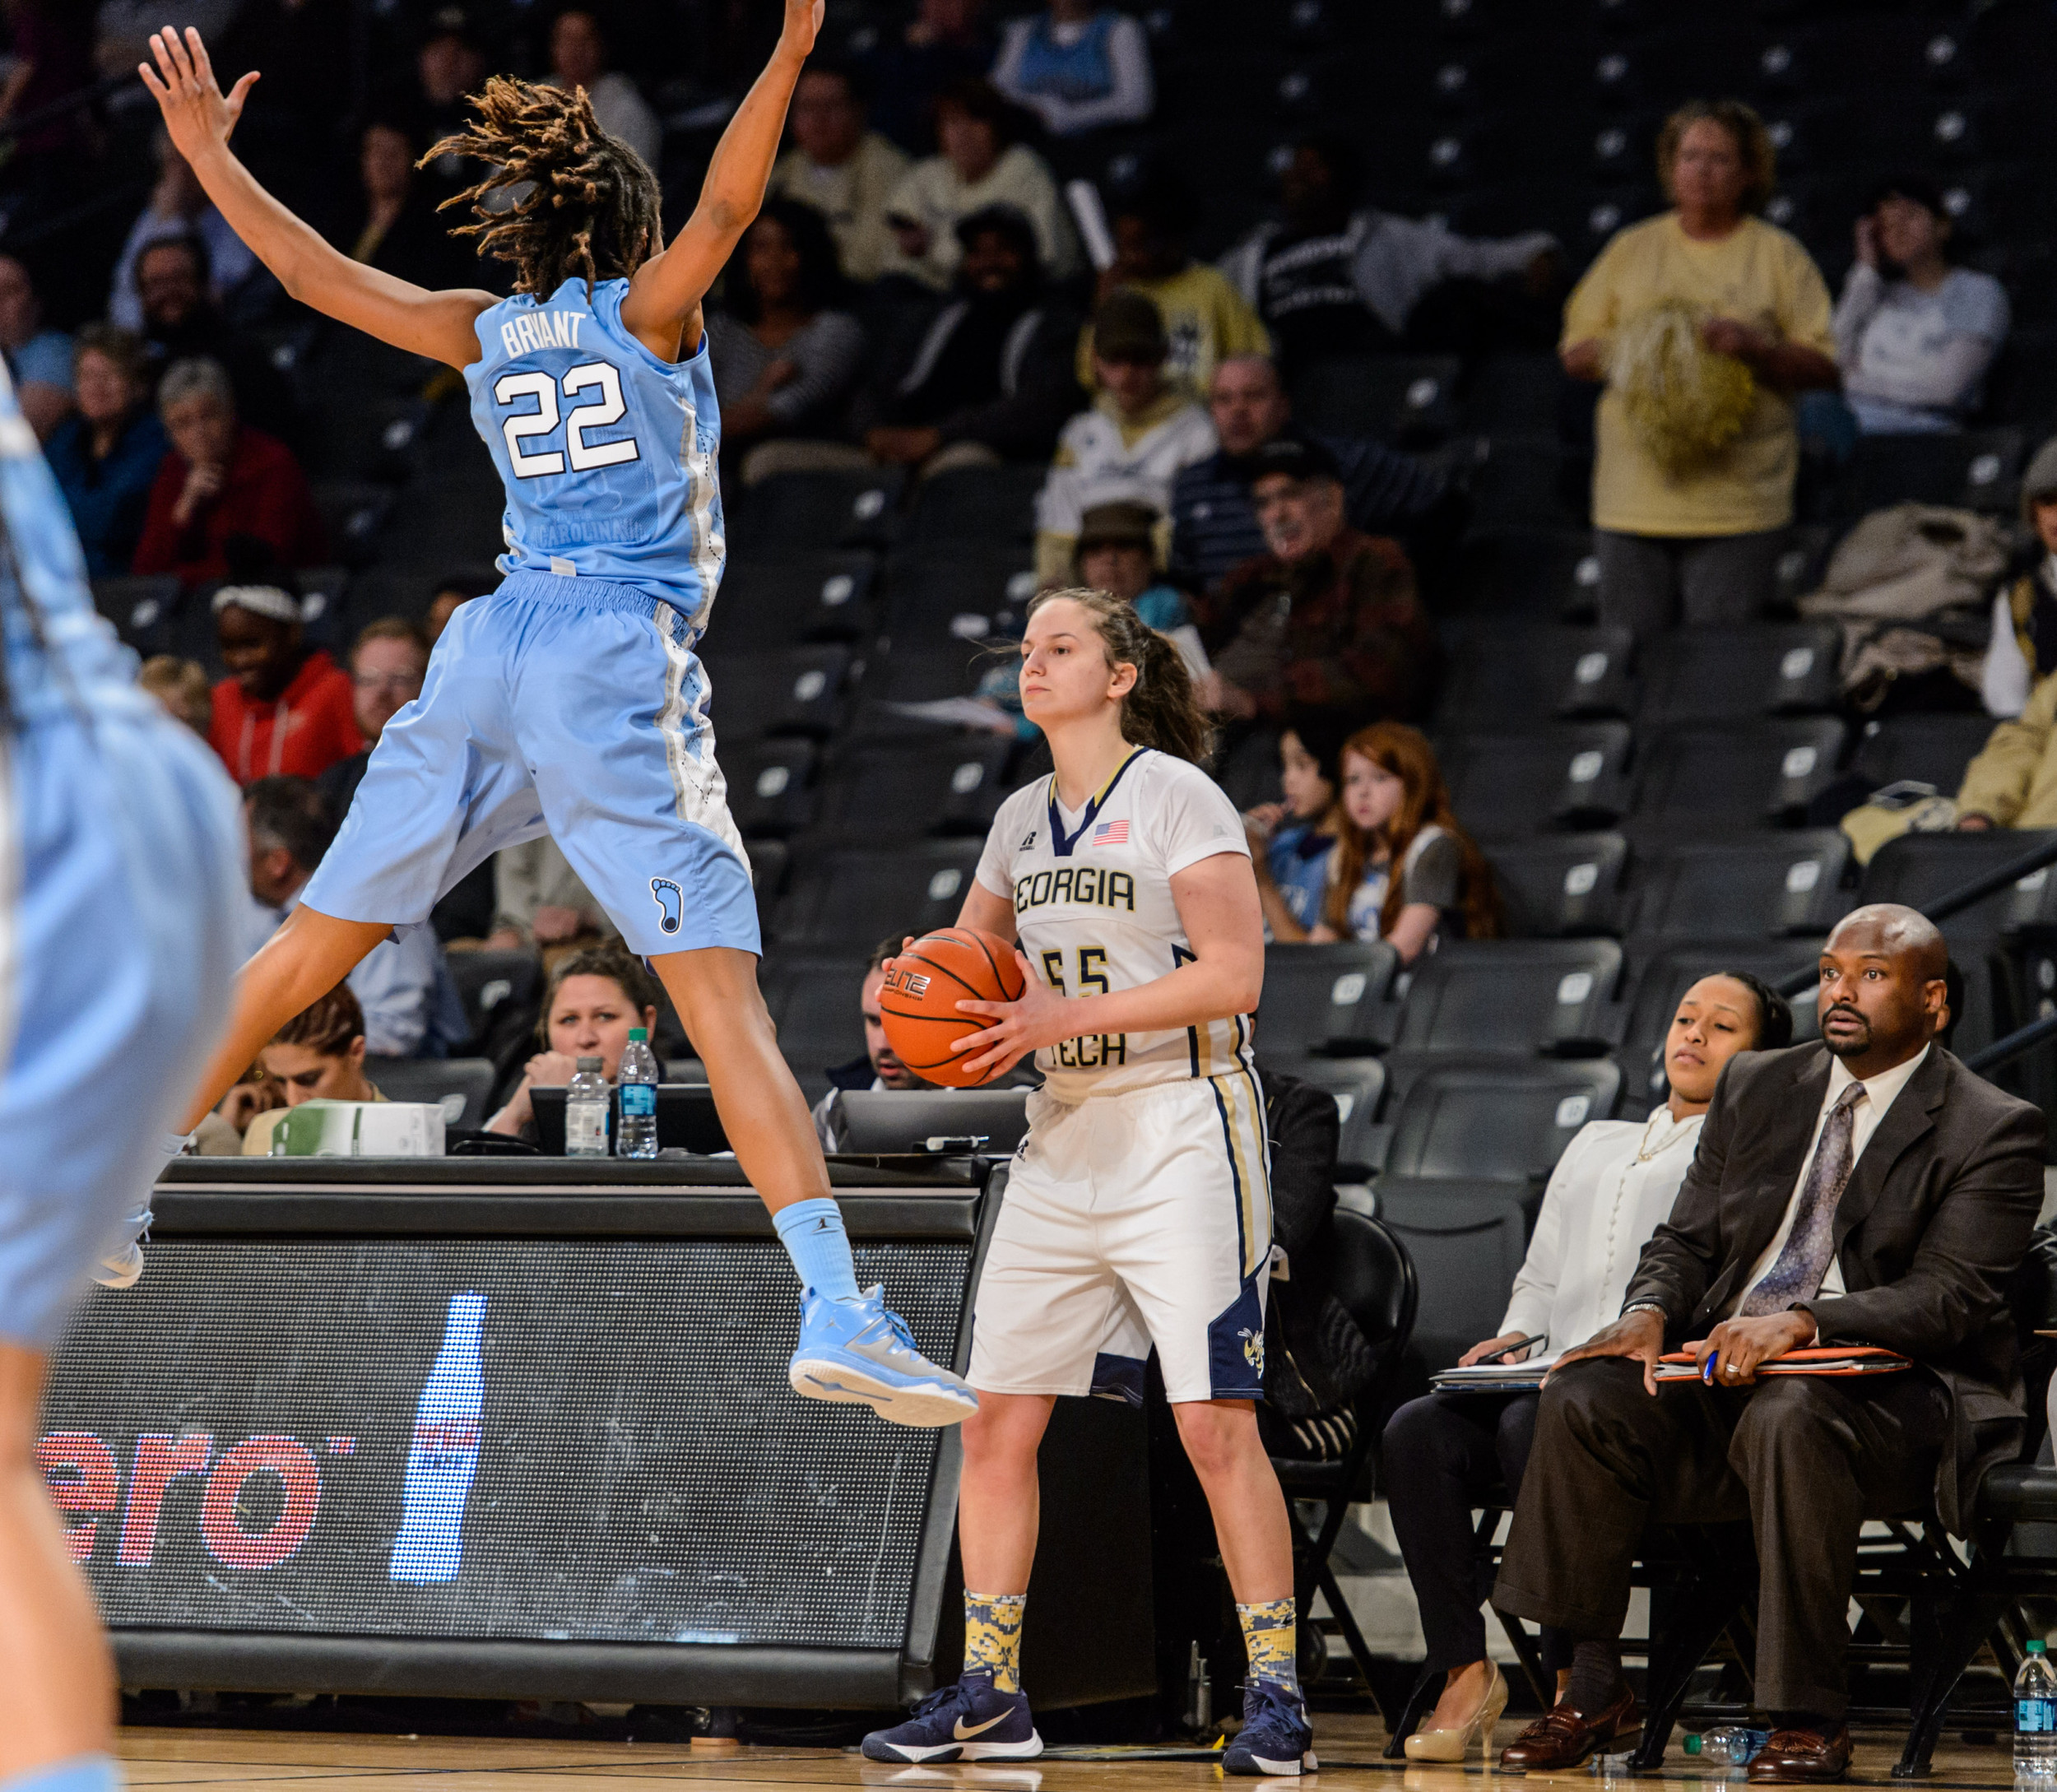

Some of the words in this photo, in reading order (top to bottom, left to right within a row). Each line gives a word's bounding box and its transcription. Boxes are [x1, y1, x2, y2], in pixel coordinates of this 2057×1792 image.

[500, 310, 587, 359] BRYANT
[494, 361, 641, 480] 22
[1014, 866, 1135, 915] EORGIA
[884, 968, 931, 996] ELITE
[1040, 945, 1111, 998] 55
[1051, 1033, 1126, 1068] ECH
